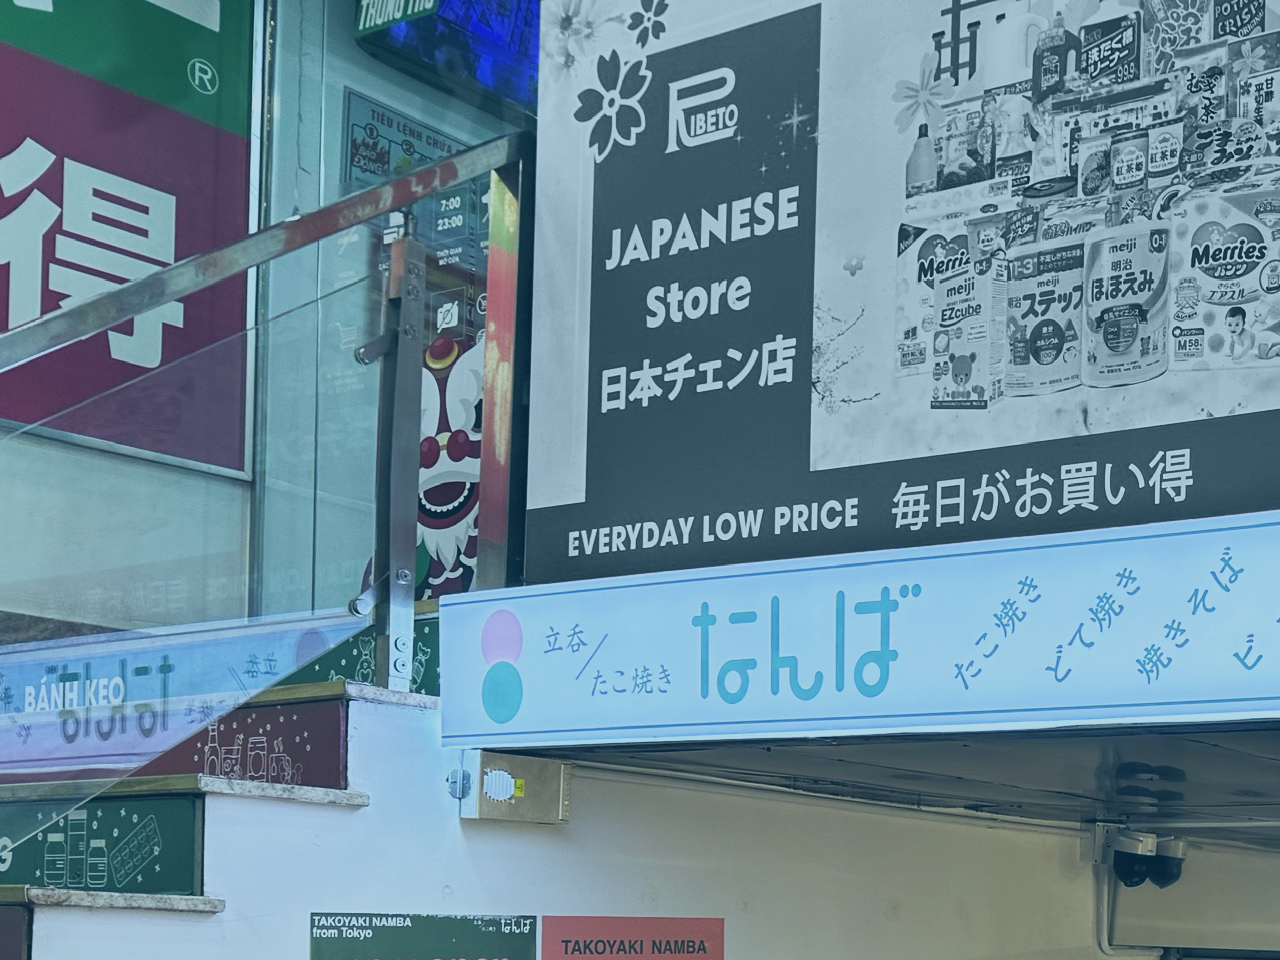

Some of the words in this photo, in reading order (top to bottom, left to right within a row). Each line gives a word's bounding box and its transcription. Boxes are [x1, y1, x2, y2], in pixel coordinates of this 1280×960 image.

[441, 196, 461, 211] 7:00
[437, 214, 463, 231] 23:00
[605, 185, 800, 271] JAPANESE
[1108, 237, 1137, 255] meiji
[1190, 239, 1268, 268] Merries
[645, 275, 752, 329] Store
[946, 276, 975, 297] meiji
[941, 304, 982, 323] EZcube
[601, 333, 797, 415] 日本チェン店
[891, 447, 1194, 532] 毎日がお買い得
[567, 516, 694, 557] EVERYDAY
[702, 507, 764, 542] LOW
[774, 497, 859, 534] PRICE
[953, 575, 1043, 691] たこ焼き
[1044, 567, 1142, 684] どて焼き
[1135, 545, 1245, 686] 焼きそば
[543, 624, 589, 655] 立呑
[691, 582, 923, 705] なんば
[24, 676, 78, 713] BÁNH
[591, 663, 674, 698] たこ焼き
[313, 916, 369, 927] TAKOYAKI
[372, 916, 412, 927] NAMBA
[313, 927, 338, 938] from
[341, 927, 373, 940] Tokyo
[561, 940, 643, 955] TAKOYAKI
[651, 940, 707, 955] NAMBA
